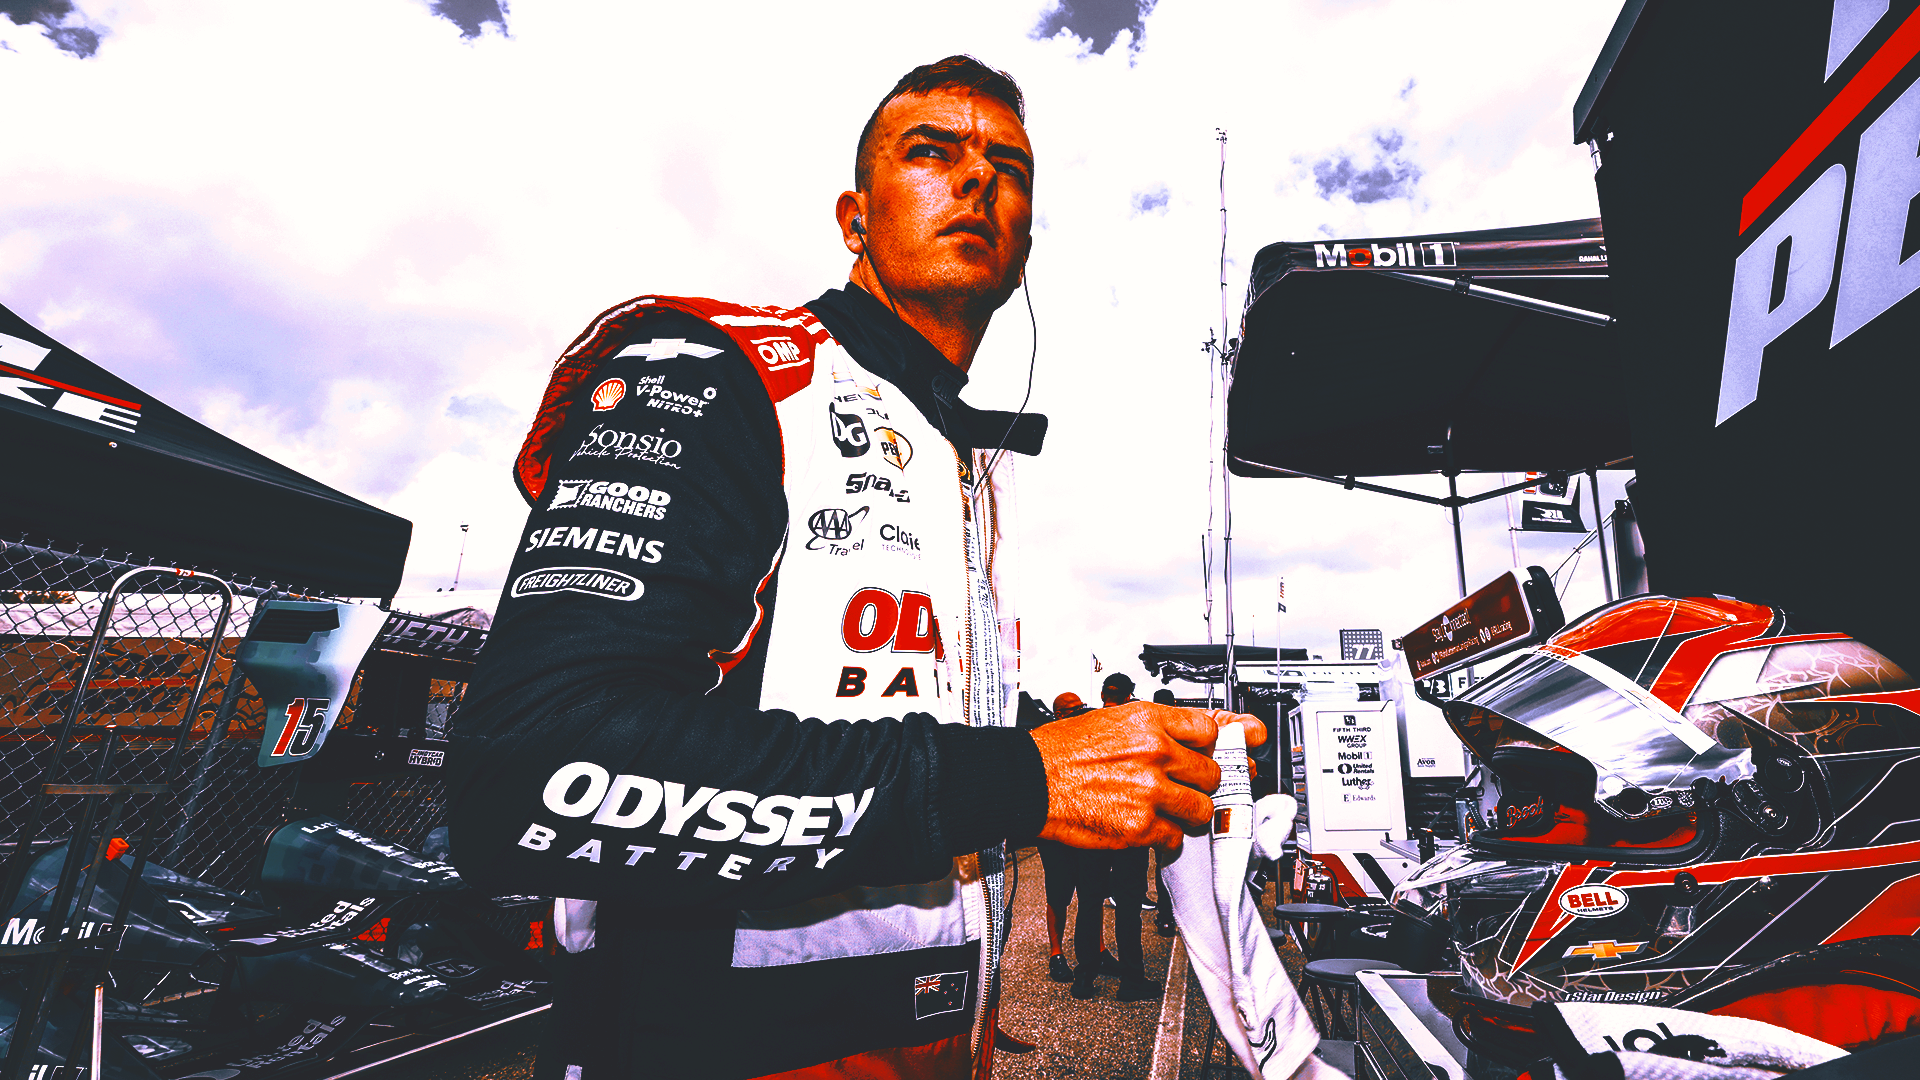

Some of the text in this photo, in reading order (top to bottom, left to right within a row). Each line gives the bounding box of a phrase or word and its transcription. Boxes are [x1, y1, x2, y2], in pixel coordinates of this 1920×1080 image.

[1313, 242, 1416, 268] Mobil
[757, 341, 801, 365] OMP
[638, 375, 665, 385] Shell
[636, 384, 709, 409] V-Power
[588, 424, 683, 459] Sonsio
[615, 446, 682, 470] Protection
[588, 481, 671, 506] GOOD
[581, 494, 667, 520] RANCHERS
[811, 509, 851, 540] AAA
[525, 526, 665, 564] SIEMENS
[829, 539, 865, 556] Trael
[519, 573, 631, 595] FREIGHTLINER
[271, 698, 331, 757] 15
[409, 756, 441, 766] HYBRID
[1338, 752, 1362, 760] Mobil
[1342, 777, 1371, 786] Luther
[542, 761, 875, 846] ODYSSEY
[518, 823, 844, 881] BATTERY
[1567, 892, 1618, 908] BELL
